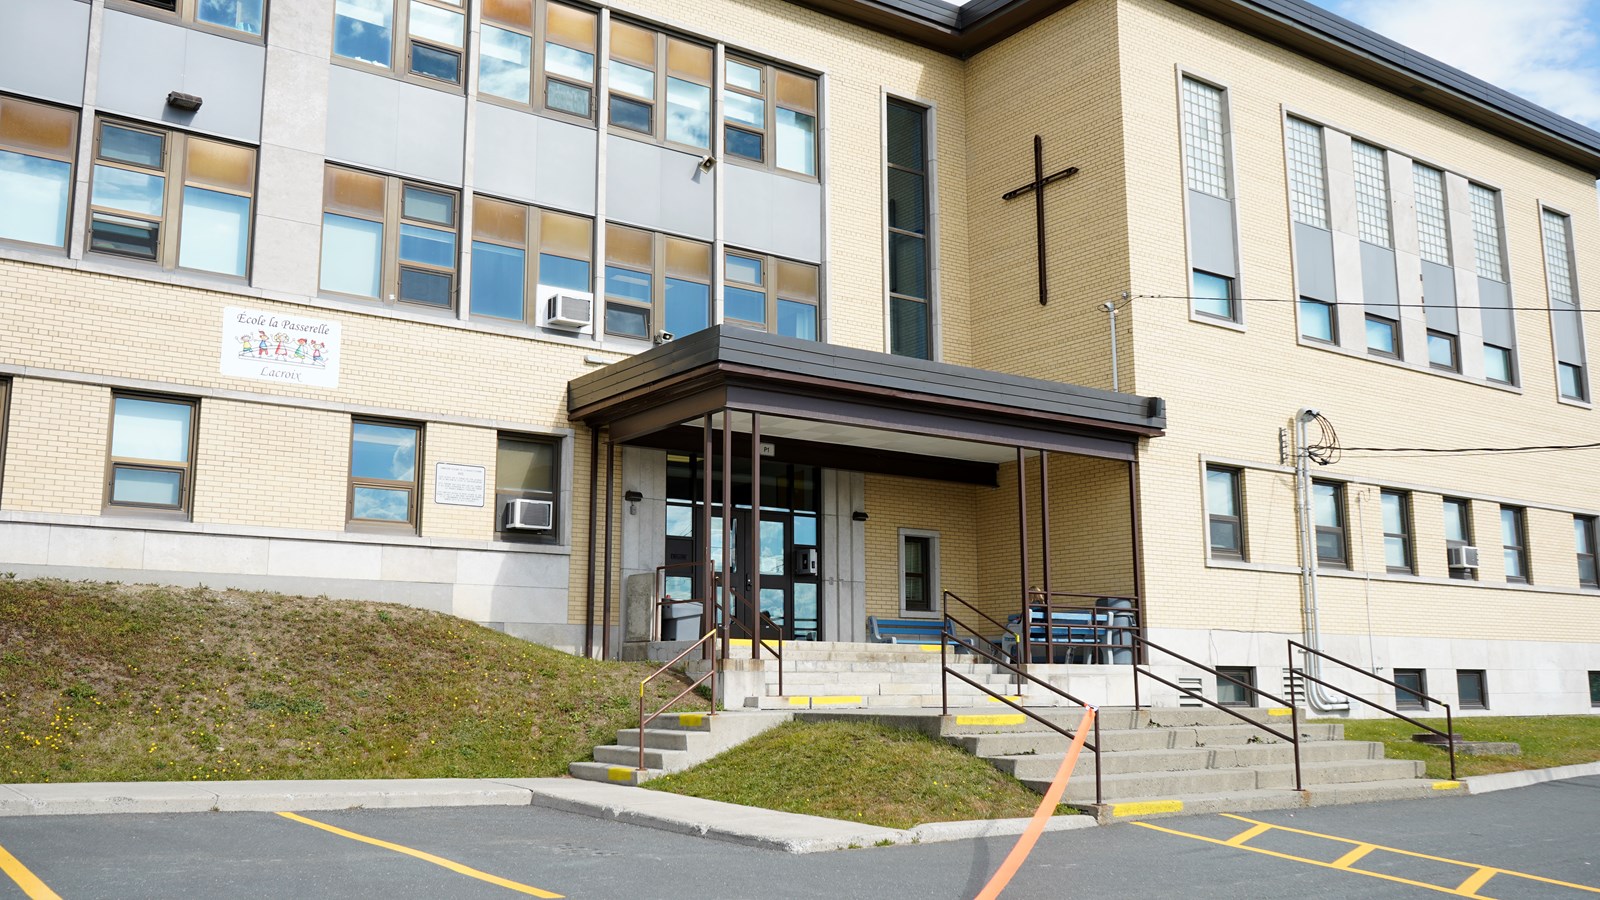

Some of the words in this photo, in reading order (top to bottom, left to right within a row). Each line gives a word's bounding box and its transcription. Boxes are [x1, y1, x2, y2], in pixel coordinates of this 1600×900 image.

[237, 311, 266, 326] École
[269, 317, 278, 328] la
[281, 319, 330, 335] Passerelle
[260, 366, 302, 382] Lacroix
